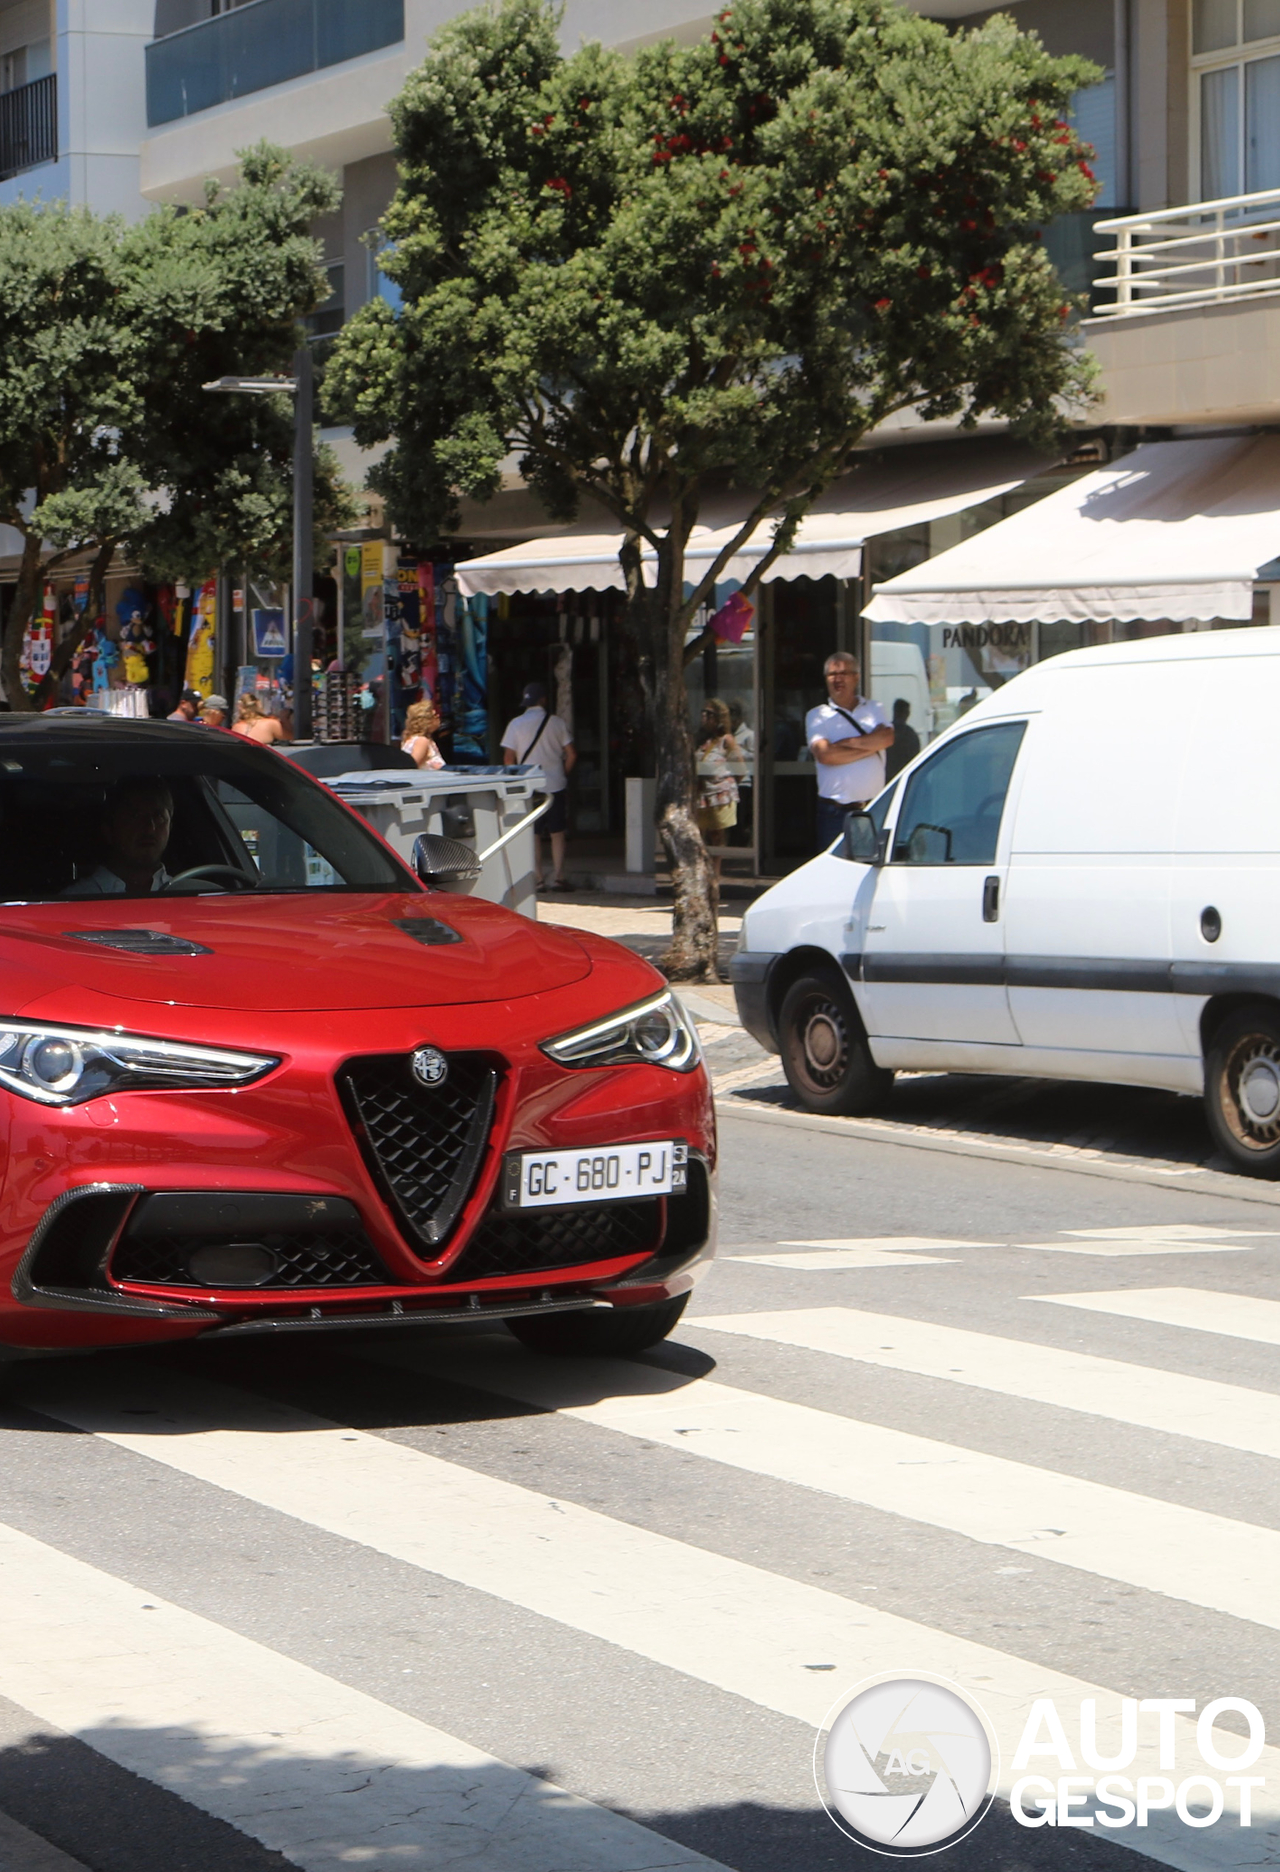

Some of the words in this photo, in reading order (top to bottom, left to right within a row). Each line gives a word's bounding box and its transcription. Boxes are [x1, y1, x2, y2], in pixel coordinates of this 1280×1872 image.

[942, 625, 1027, 649] PANDORA
[672, 1169, 687, 1186] 2A
[509, 1189, 517, 1201] F
